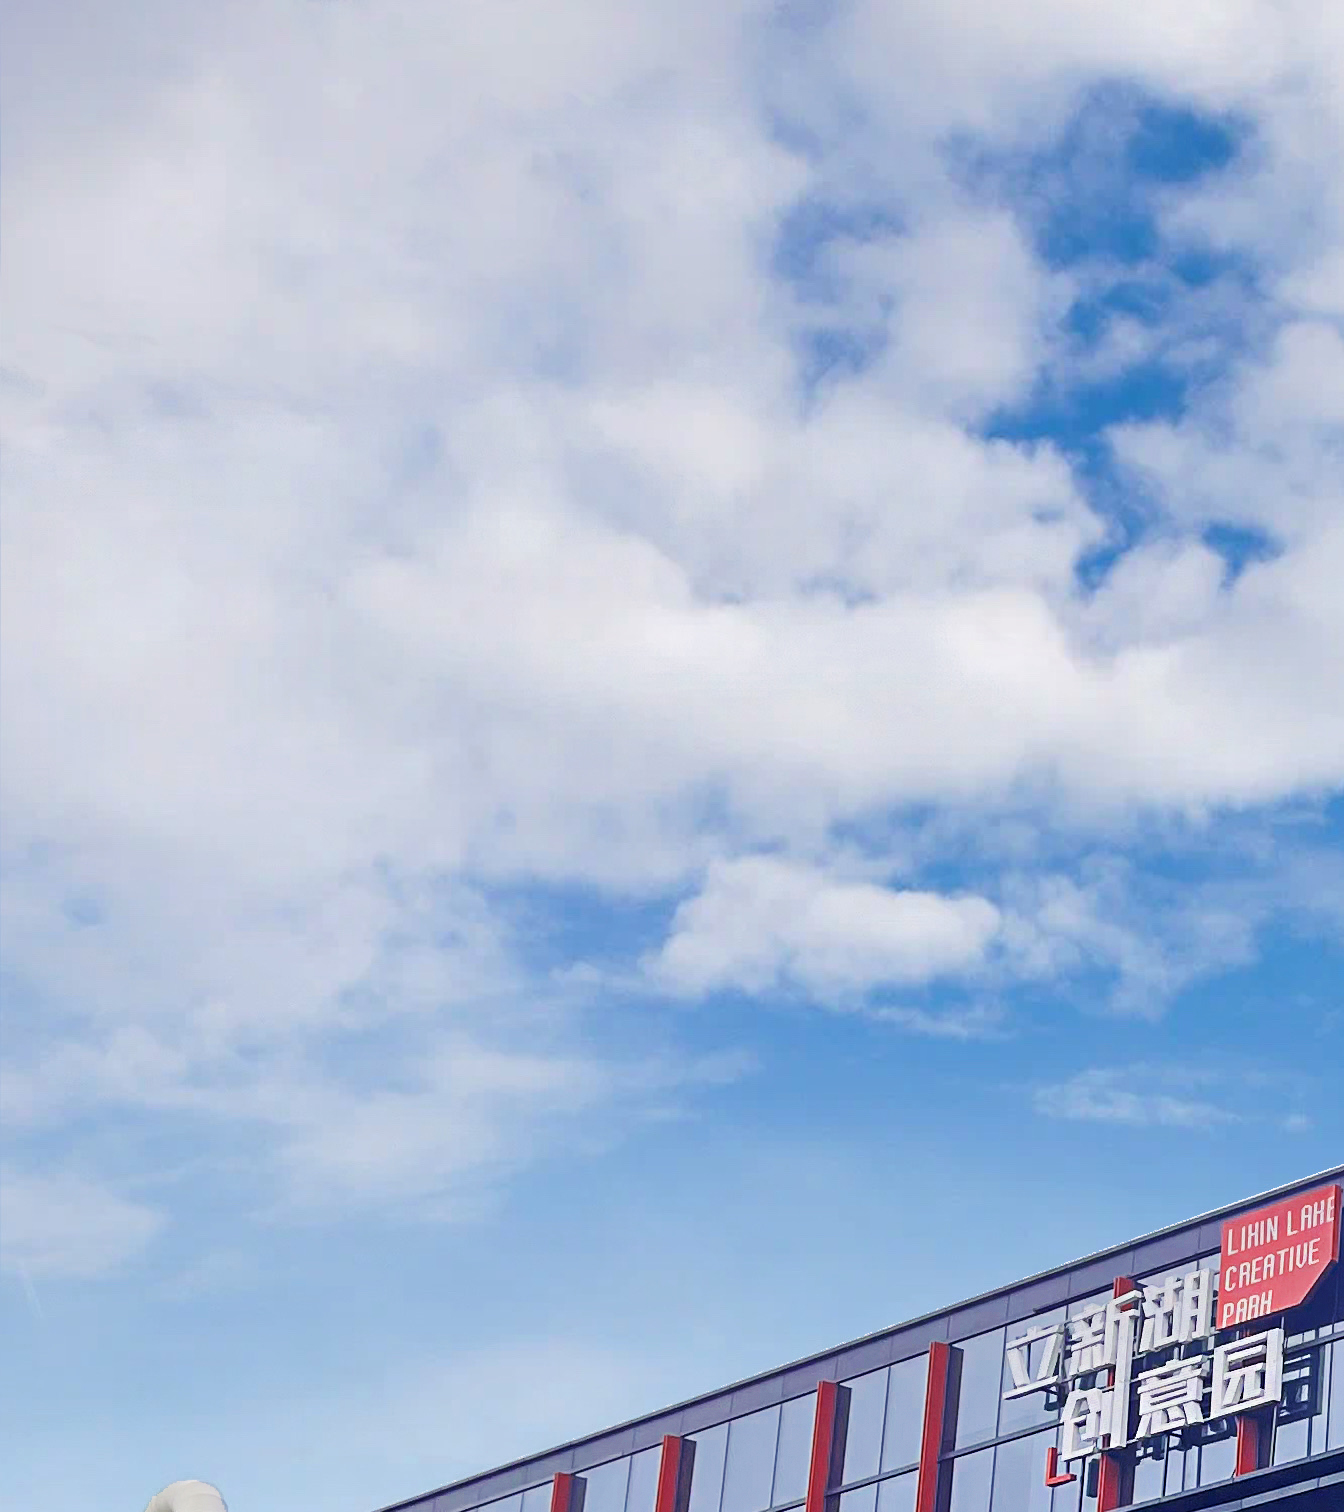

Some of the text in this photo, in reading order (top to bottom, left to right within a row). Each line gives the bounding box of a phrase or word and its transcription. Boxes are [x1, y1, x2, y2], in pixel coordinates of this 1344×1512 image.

[1224, 1238, 1321, 1292] CREATIVE
[1001, 1268, 1214, 1400] 立新湖
[1060, 1327, 1285, 1462] 创意园
